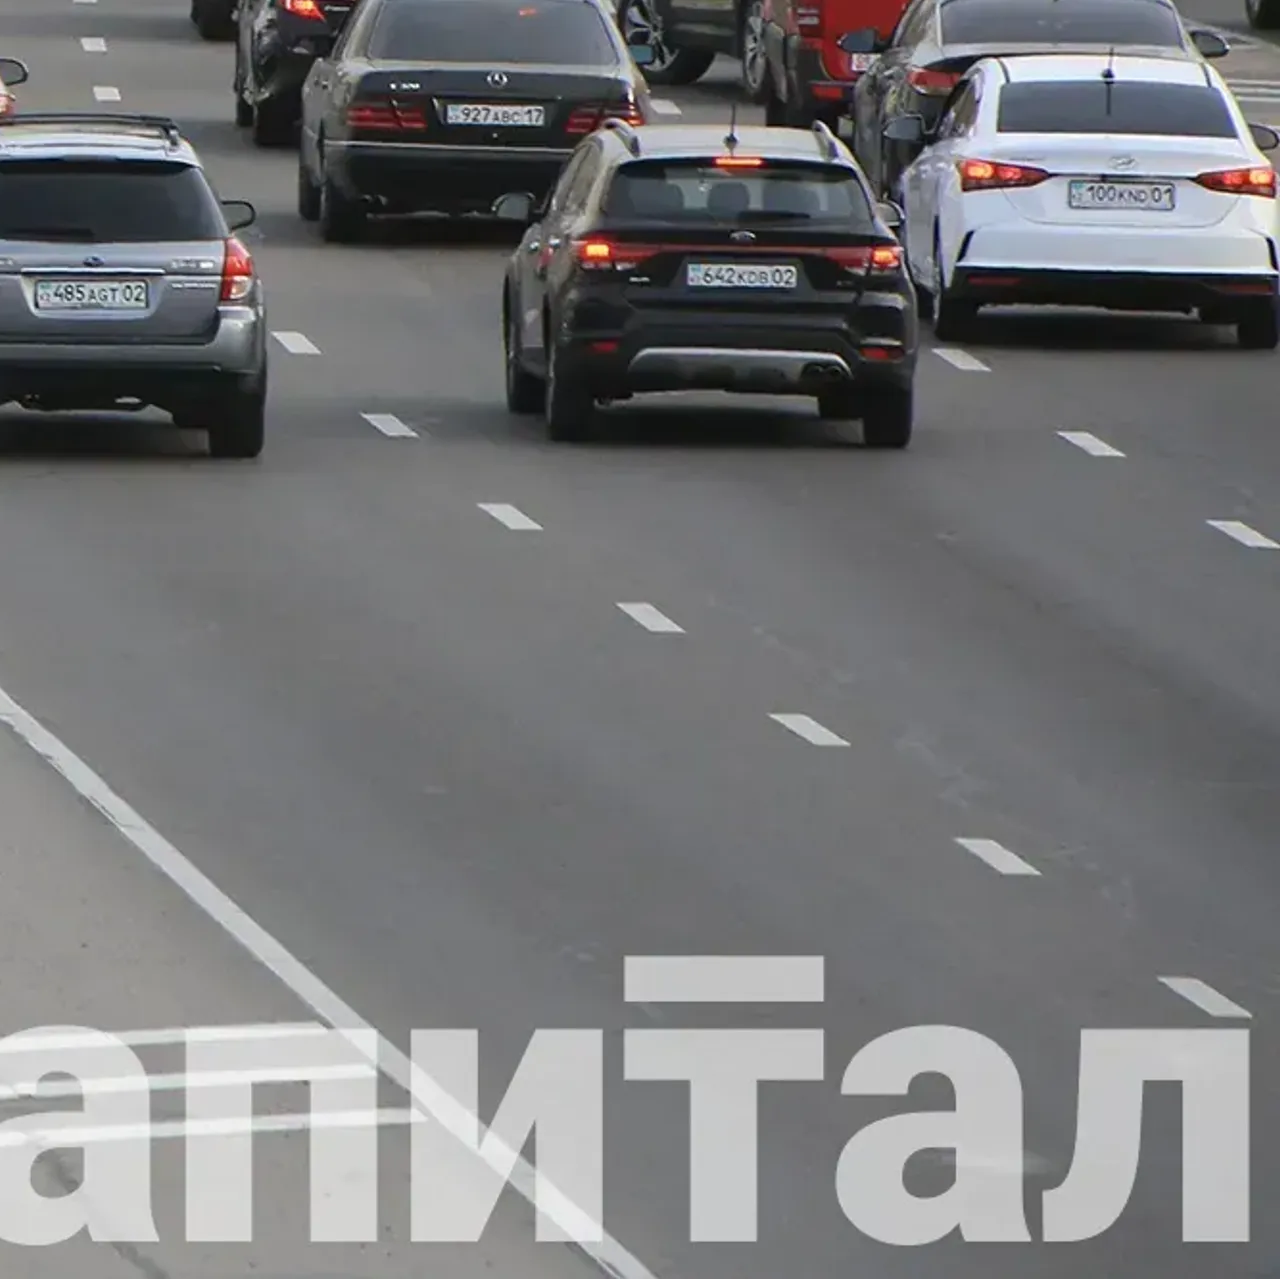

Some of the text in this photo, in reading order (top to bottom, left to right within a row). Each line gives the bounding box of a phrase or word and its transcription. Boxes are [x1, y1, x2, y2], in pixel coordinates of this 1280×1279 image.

[525, 107, 542, 124] 17
[773, 268, 794, 285] 02
[122, 284, 145, 302] 02
